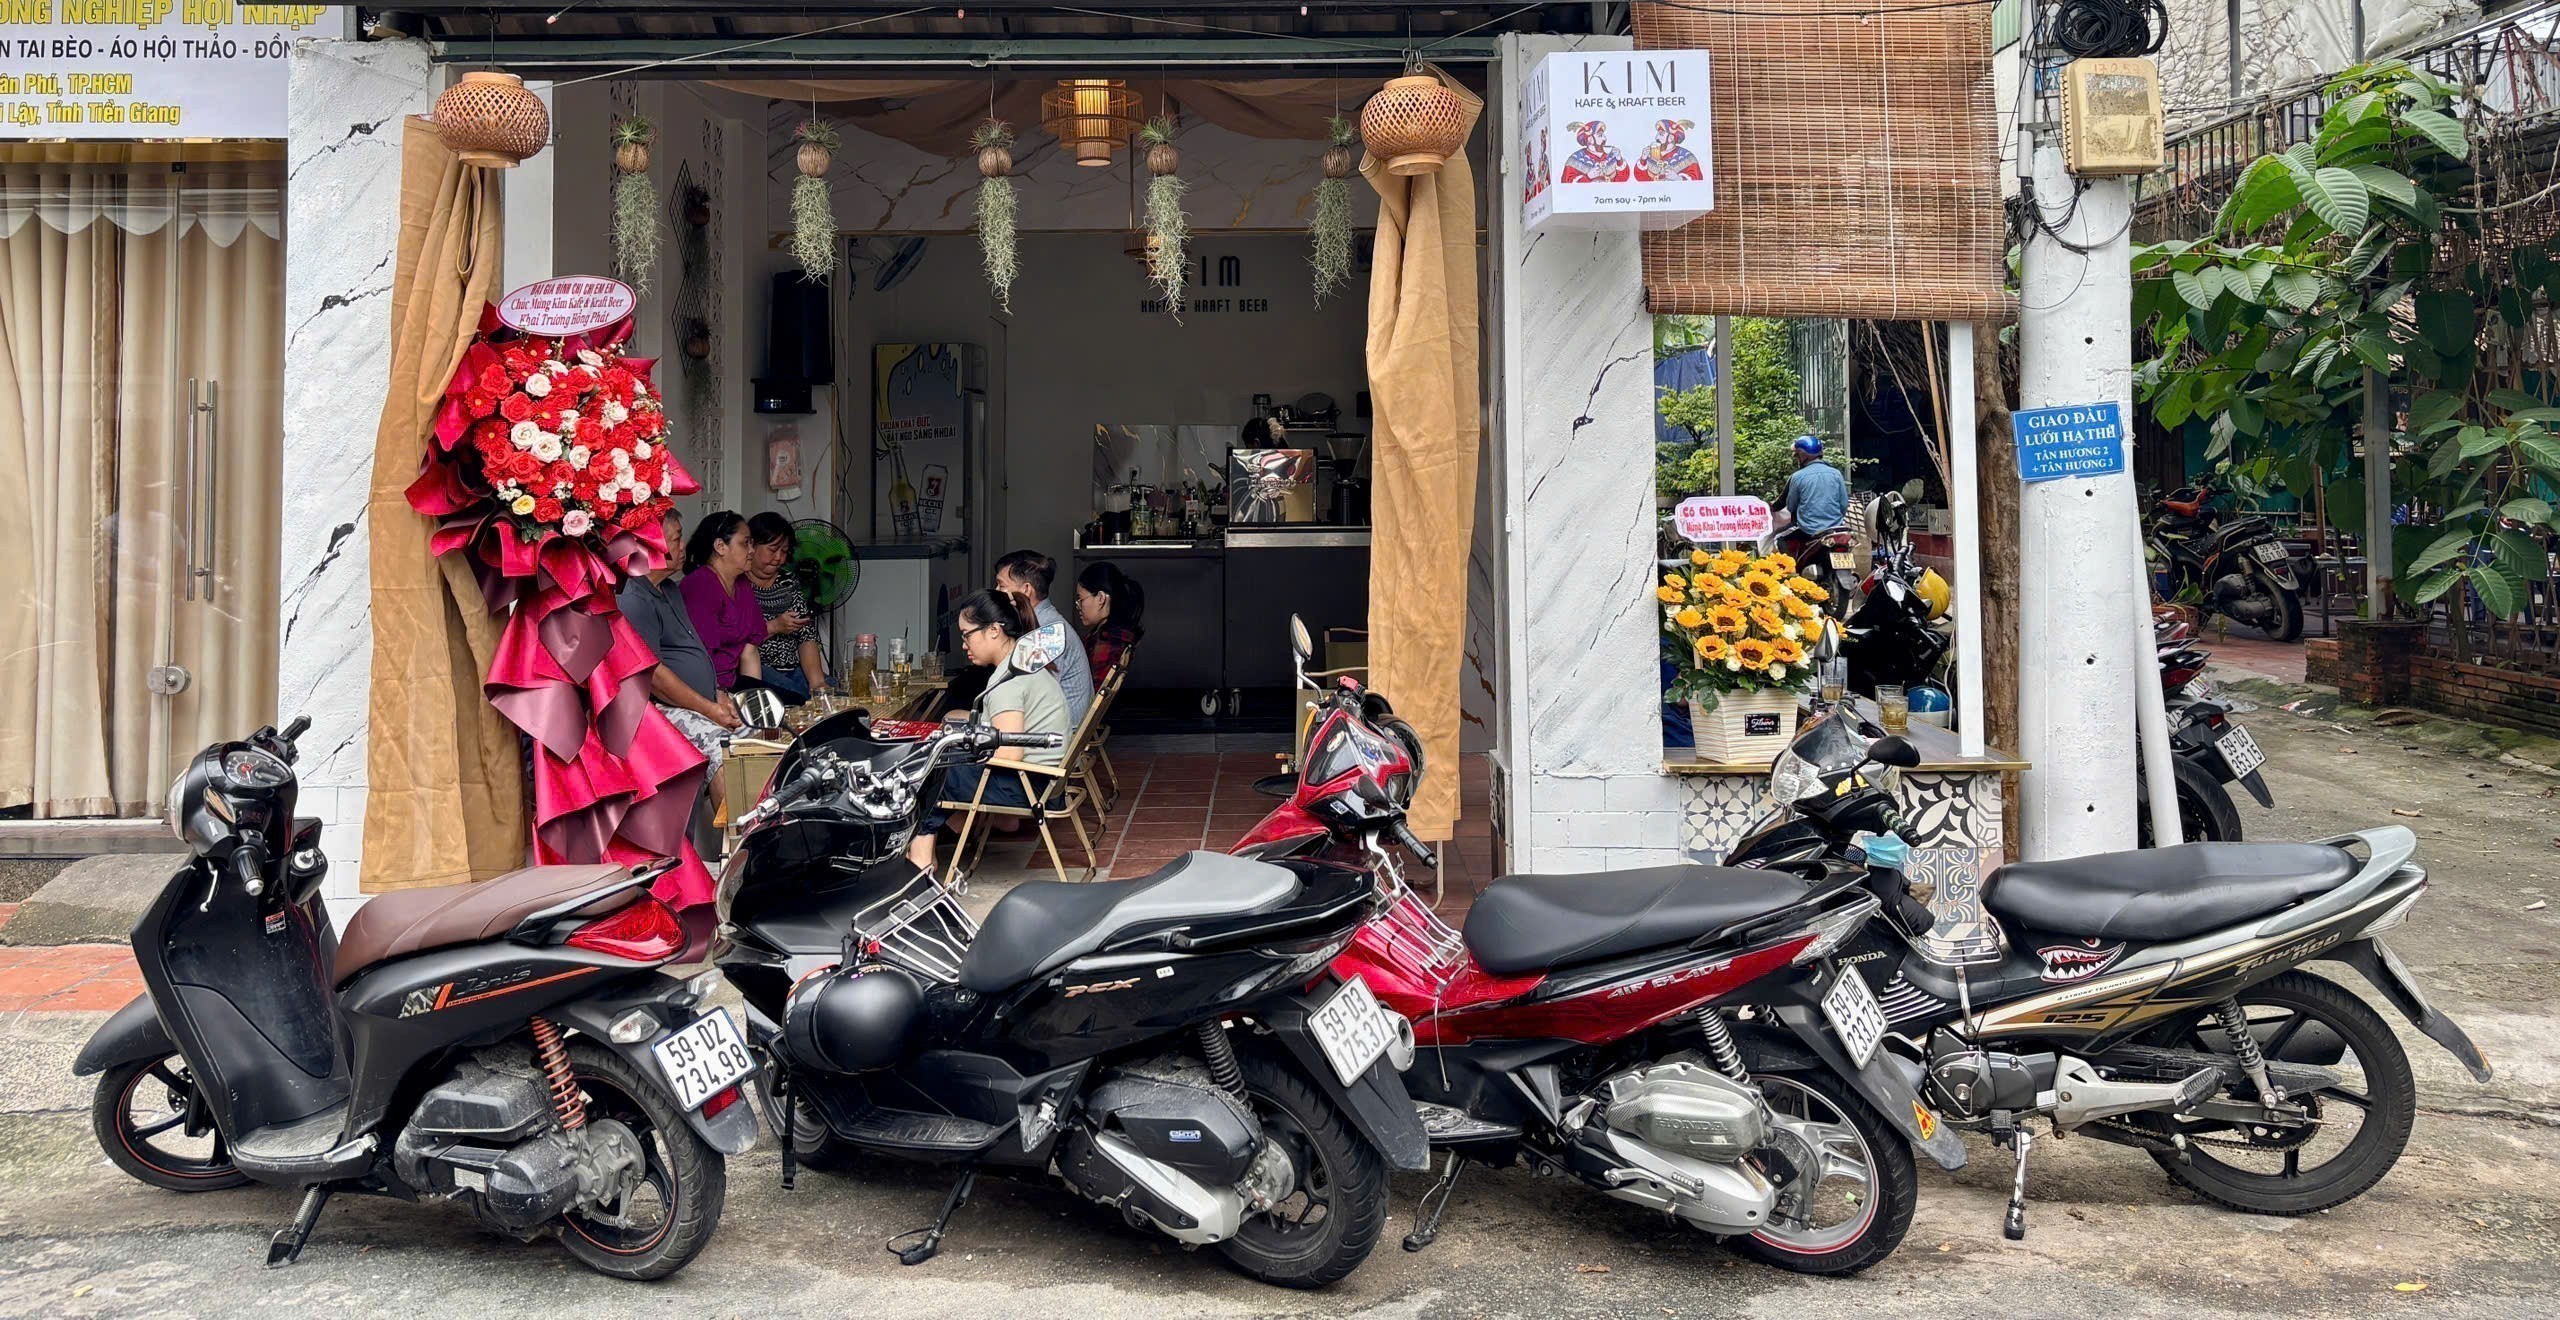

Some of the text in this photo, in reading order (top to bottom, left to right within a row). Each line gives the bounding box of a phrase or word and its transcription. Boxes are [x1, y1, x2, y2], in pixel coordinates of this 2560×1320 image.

[17, 40, 45, 58] TAI
[52, 35, 92, 58] BÈO
[110, 35, 137, 58] ÁO
[144, 35, 176, 62] HỘI
[183, 33, 237, 59] THẢO
[24, 73, 63, 96] Phú,
[68, 73, 132, 94] TP.HCM
[1583, 60, 1676, 94] KIM
[1575, 97, 1686, 109] KAFE & KRAFT BEER
[88, 99, 125, 123] Tiền
[130, 102, 181, 126] Giang
[1594, 196, 1613, 204] 7am
[1638, 196, 1657, 205] 7pm
[552, 297, 567, 309] Kim
[608, 296, 624, 307] Beer
[1239, 299, 1268, 312] BEER
[2028, 413, 2069, 429] GIAO
[2025, 430, 2059, 446] LƯỚI
[2063, 430, 2085, 444] HẠ
[2034, 446, 2109, 461] TÂN HƯƠNG 2
[2040, 461, 2063, 473] TÂN
[2065, 458, 2106, 471] HƯƠNG
[2108, 458, 2113, 467] 3
[1699, 505, 1719, 517] Chú
[1748, 505, 1766, 515] Lan
[2232, 744, 2263, 775] 353.15
[1838, 950, 1887, 966] HONDA
[1064, 977, 1141, 998] PCX
[1320, 986, 1367, 1041] 59-D3
[2043, 1012, 2109, 1023] 125
[1846, 1000, 1883, 1060] 233.73
[666, 1018, 727, 1068] 59-D2
[1336, 1011, 1387, 1074] 175.37
[676, 1043, 748, 1104] 734.98
[1655, 1117, 1728, 1131] HONDA
